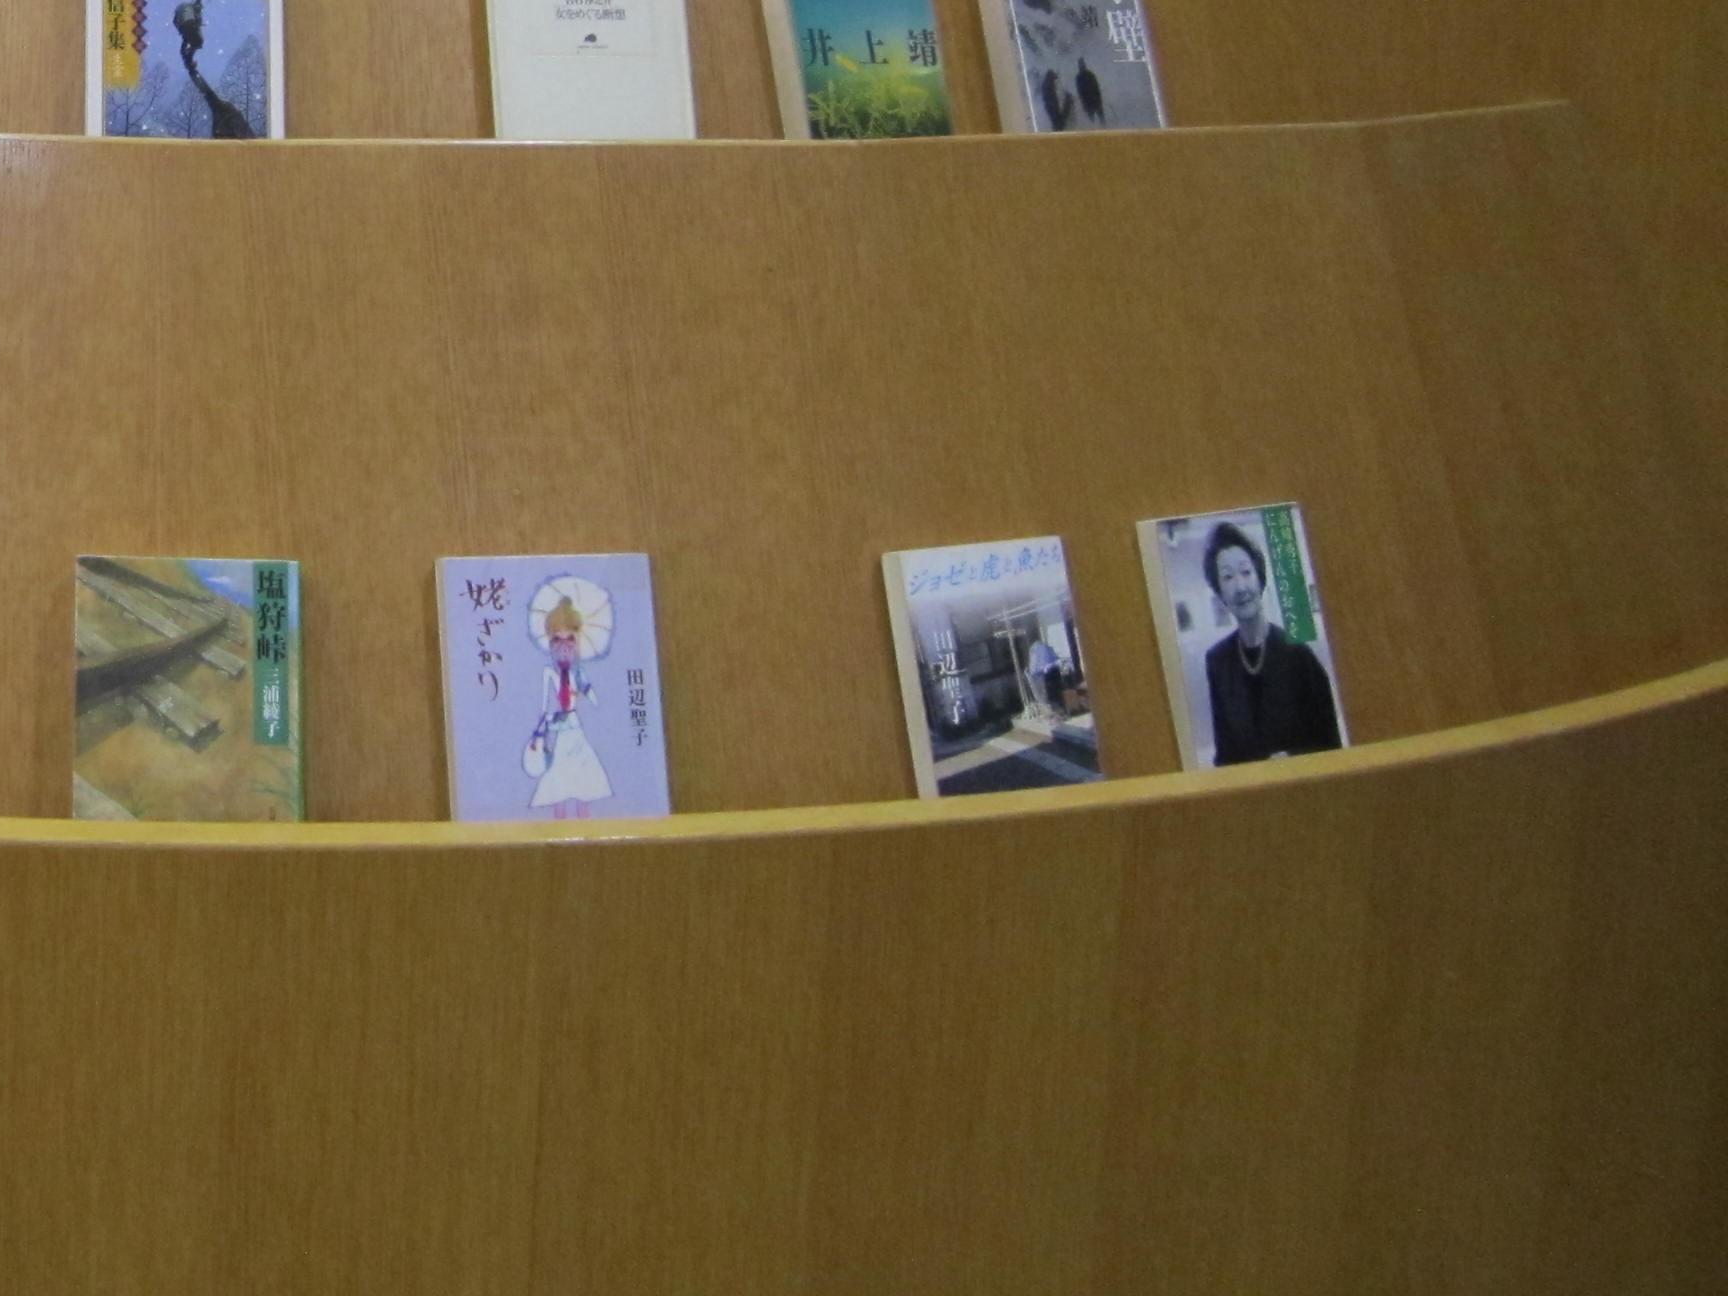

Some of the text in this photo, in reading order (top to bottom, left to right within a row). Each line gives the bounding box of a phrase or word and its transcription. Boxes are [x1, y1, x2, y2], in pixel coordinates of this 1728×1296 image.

[801, 27, 938, 67] 井上靖
[257, 570, 286, 663] 塩狩峠
[627, 668, 648, 747] 田辺聖子
